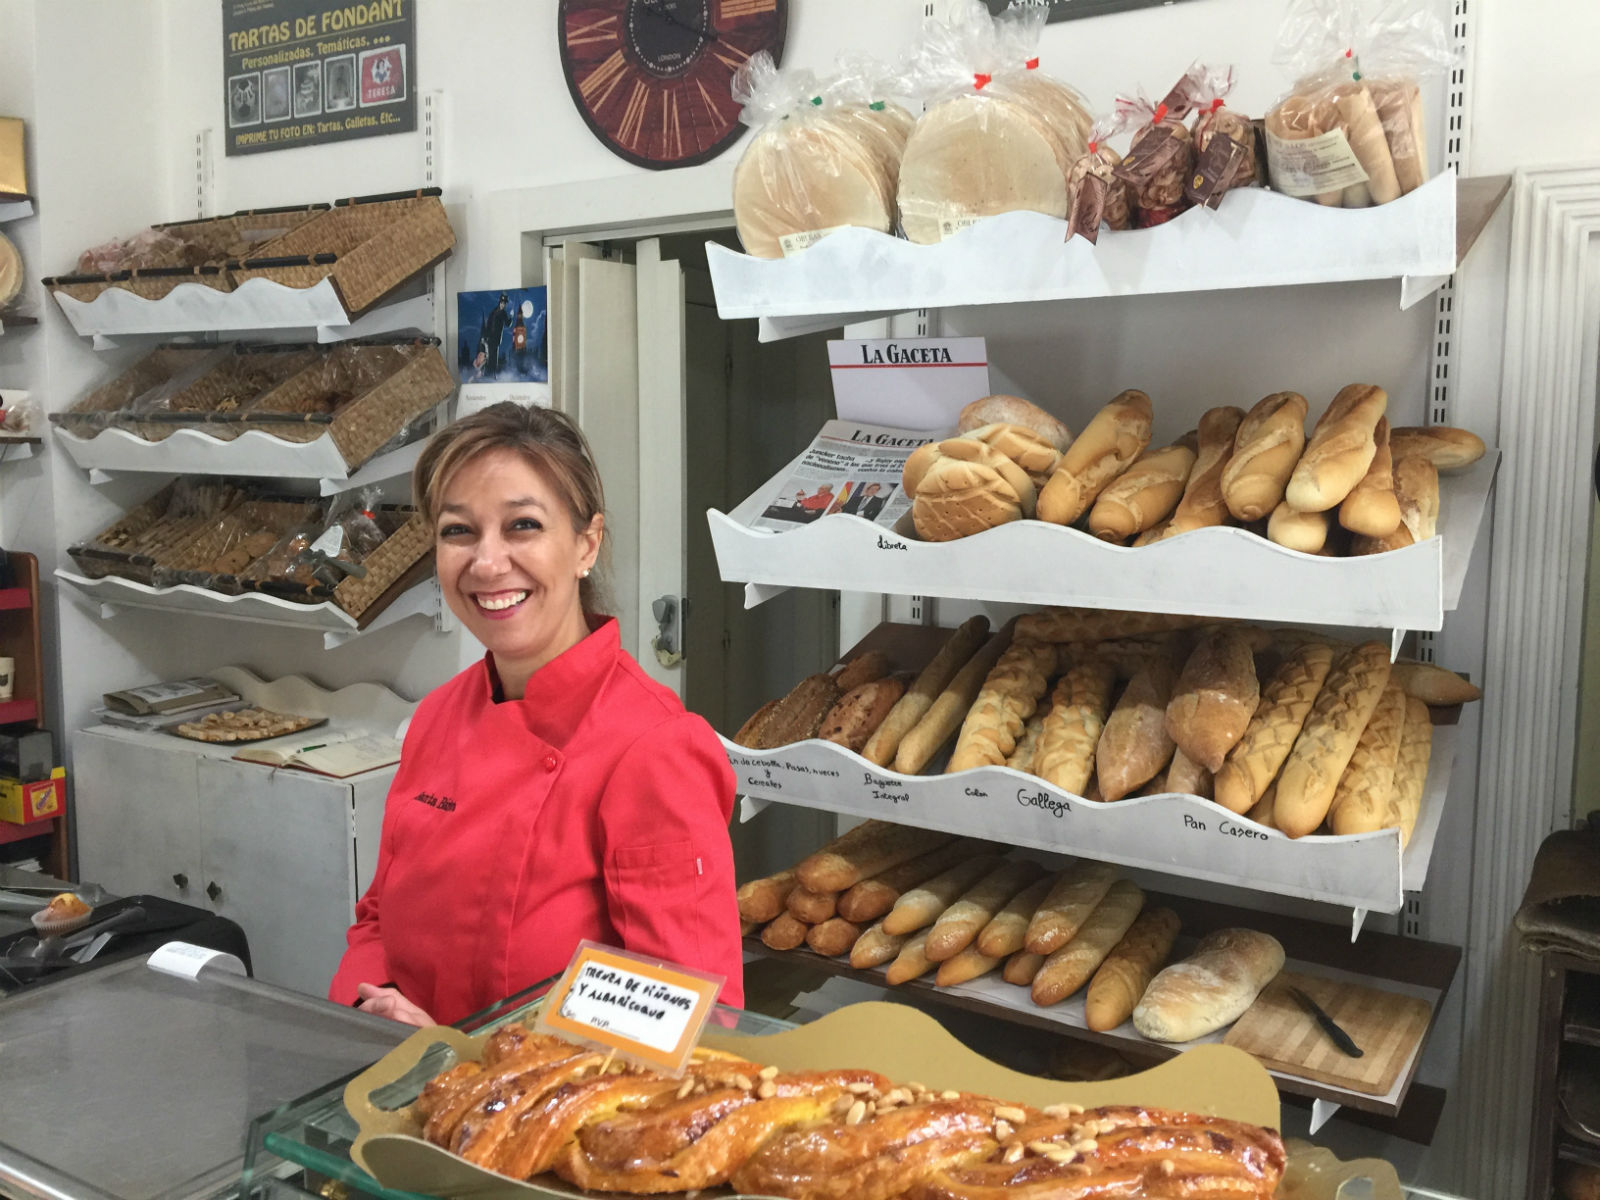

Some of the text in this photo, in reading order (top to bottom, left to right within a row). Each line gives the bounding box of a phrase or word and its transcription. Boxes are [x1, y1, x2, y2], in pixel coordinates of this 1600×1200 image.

[229, 0, 402, 52] TARTAS DE FONDANT
[235, 130, 267, 145] IMPRIME
[269, 128, 279, 140] TU
[280, 125, 300, 138] FOTO
[886, 344, 952, 364] GACETA
[1017, 788, 1072, 818] Gallega
[1184, 814, 1269, 841] Pan Casero
[586, 966, 622, 986] TRENZA
[625, 978, 640, 993] DE
[577, 982, 589, 996] Y
[588, 990, 665, 1020] ALBARICOQUE
